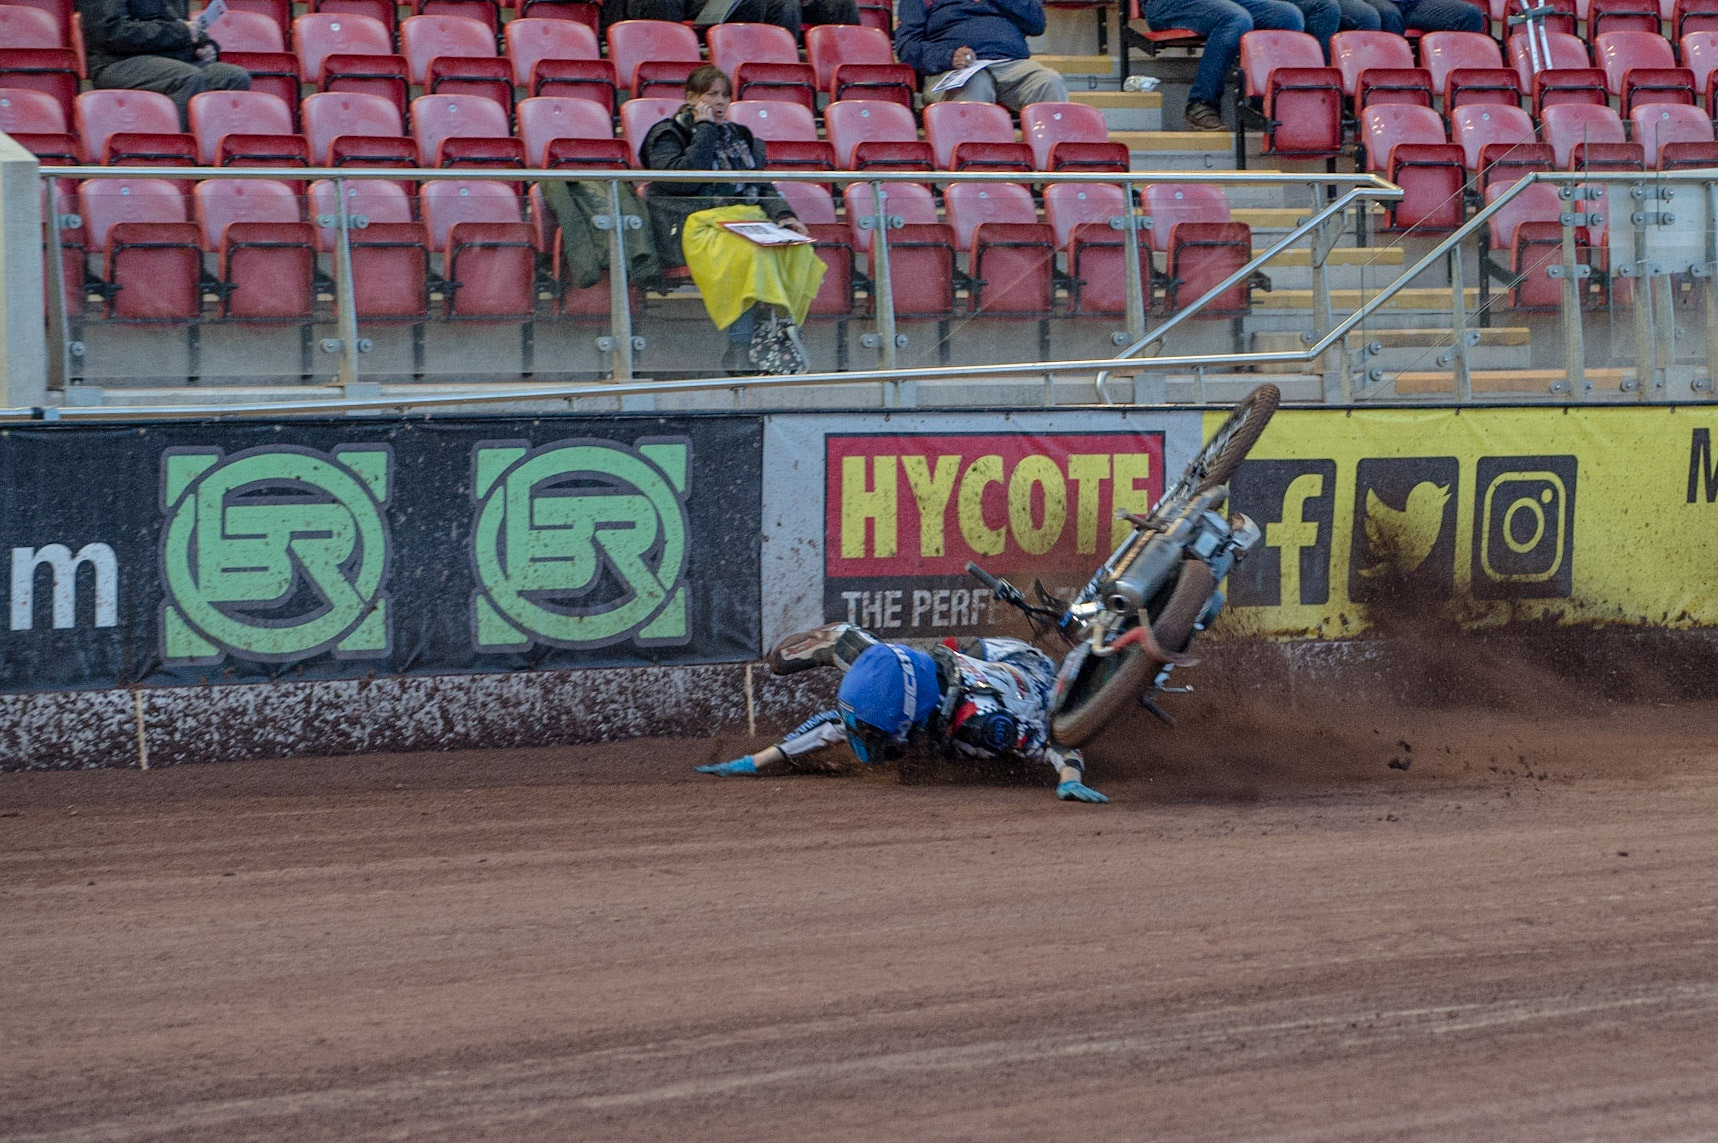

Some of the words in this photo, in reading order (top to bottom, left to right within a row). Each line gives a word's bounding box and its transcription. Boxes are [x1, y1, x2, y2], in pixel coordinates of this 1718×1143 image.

[840, 453, 1150, 559] HYCOTE
[10, 542, 118, 631] m
[840, 590, 903, 629] THE
